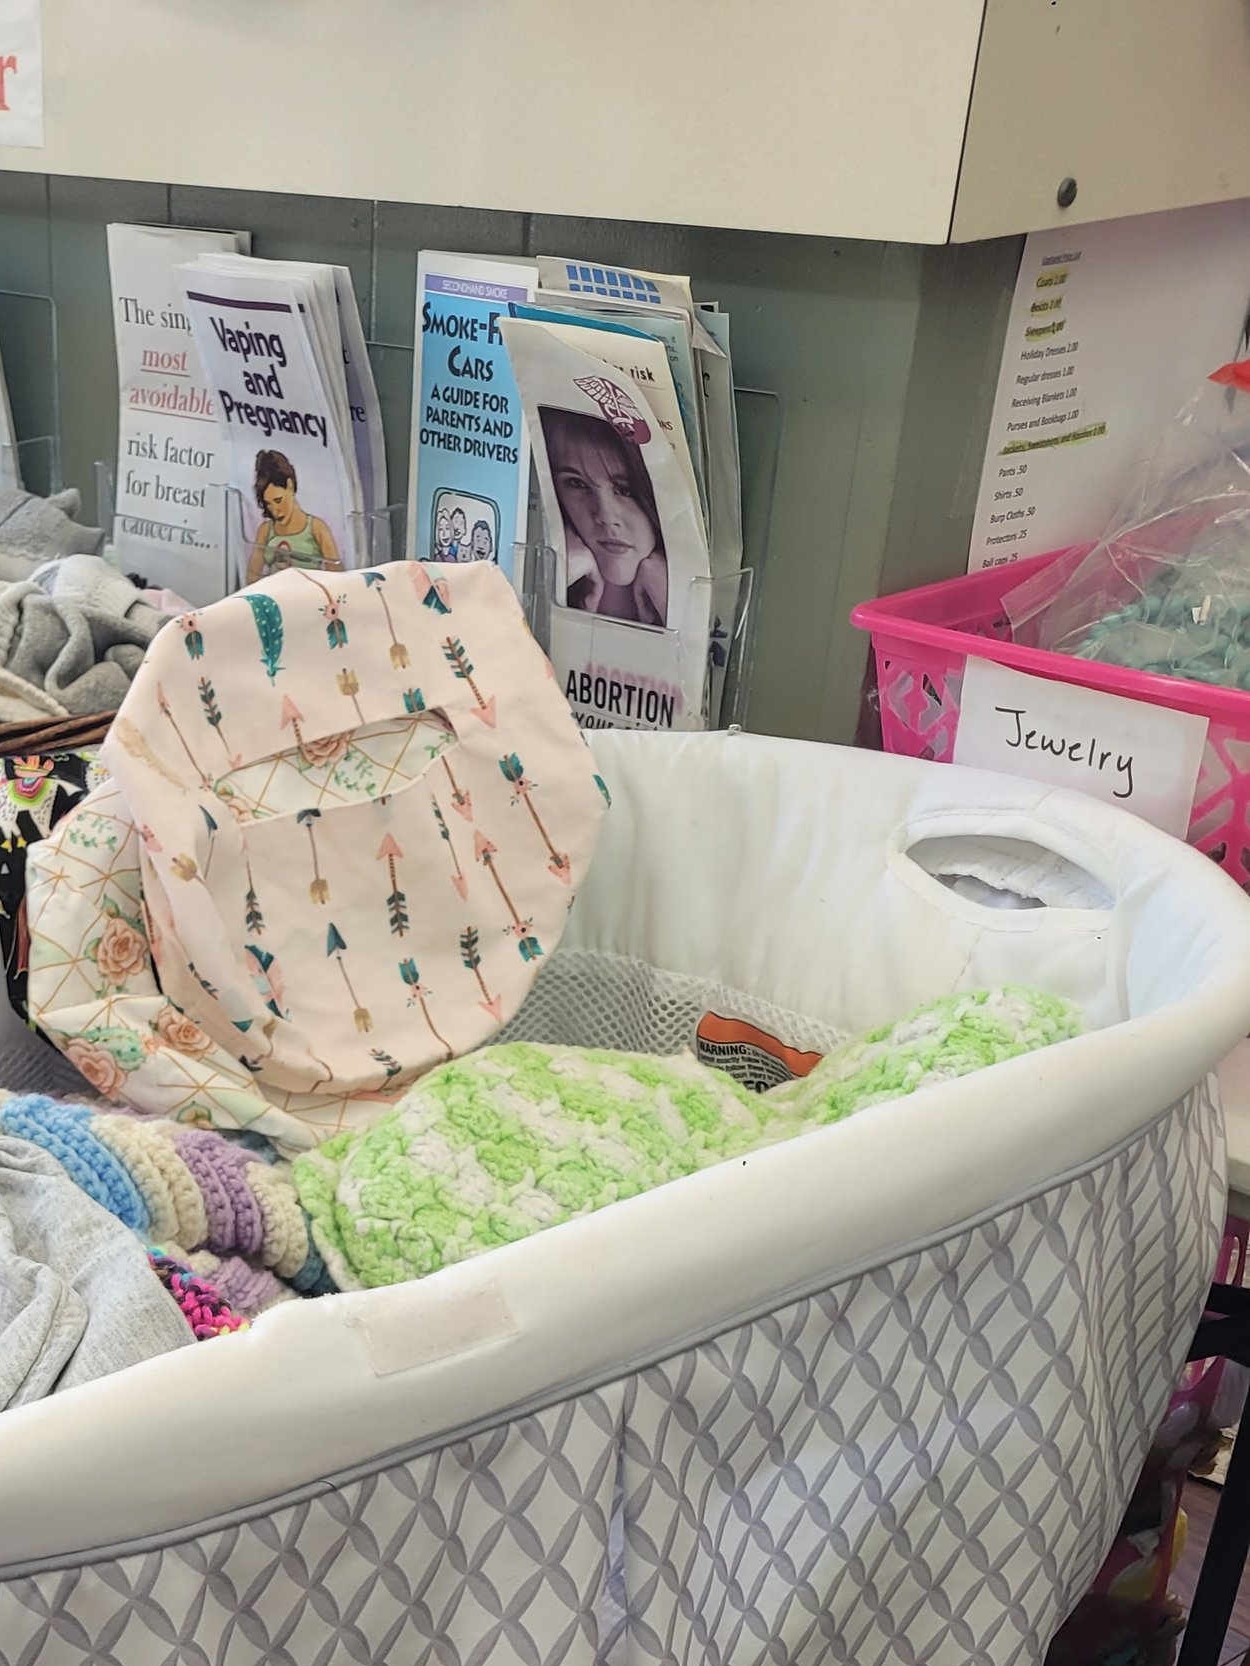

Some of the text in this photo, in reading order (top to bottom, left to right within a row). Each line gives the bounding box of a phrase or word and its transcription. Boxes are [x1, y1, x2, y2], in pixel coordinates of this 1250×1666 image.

[485, 287, 508, 299] SMOKE
[1036, 277, 1053, 288] Coats
[119, 296, 155, 326] The
[1031, 302, 1048, 313] Boots
[209, 316, 287, 367] Vaping
[1020, 341, 1079, 360] Holiday Dresses 2.00
[142, 349, 187, 371] most
[243, 364, 283, 399] and
[630, 366, 655, 382] risk
[1016, 365, 1075, 386] Regular dresses 1.00
[129, 383, 215, 415] avoidable
[431, 384, 509, 415] A GUIDE FOR
[1011, 387, 1077, 408] Receiving Blankets 1.00
[218, 389, 328, 447] Pregnancy
[426, 406, 513, 439] PARENTS AND
[1007, 409, 1079, 432] Purses and Bookbags 1.00
[127, 432, 214, 469] risk factor
[420, 428, 518, 465] OTHER DRIVERS
[998, 464, 1027, 478] Pants .50
[125, 469, 206, 507] for breast
[993, 487, 1024, 501] Shirts .50
[990, 506, 1036, 524] Burp Cloths .50
[986, 533, 1017, 546] Protectors
[982, 558, 994, 568] Ball
[995, 556, 1008, 566] caps
[565, 669, 675, 729] ABORTION
[995, 706, 1133, 798] Jewelry
[699, 1041, 751, 1056] WARNING:
